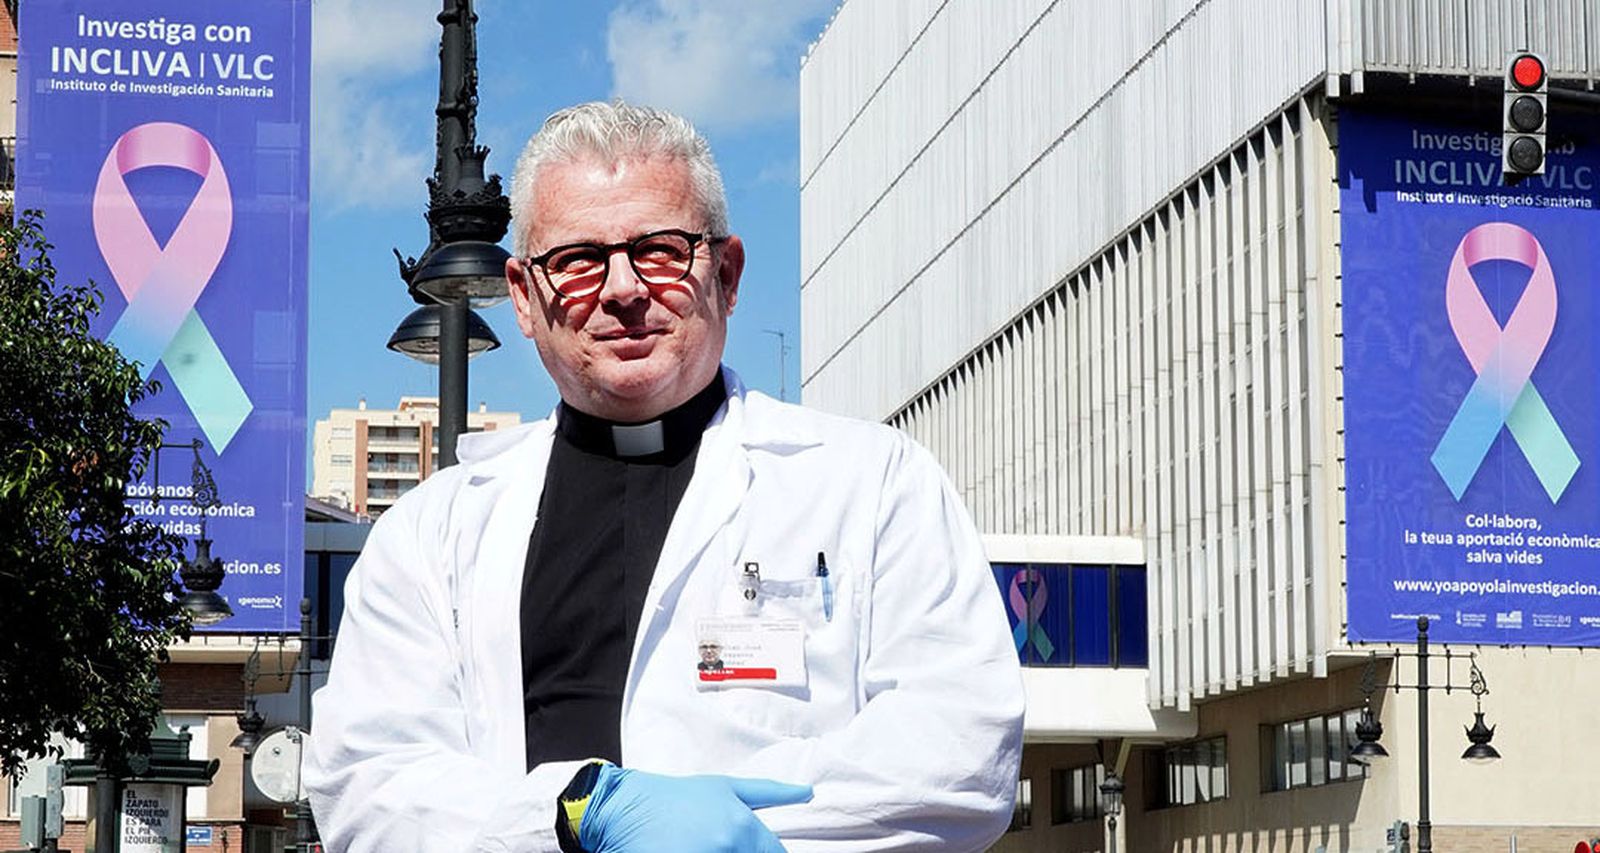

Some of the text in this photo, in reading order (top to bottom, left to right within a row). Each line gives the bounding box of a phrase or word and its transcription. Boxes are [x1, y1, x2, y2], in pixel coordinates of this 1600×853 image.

[78, 14, 251, 45] Investiga con
[51, 46, 274, 80] INCLIVA VLC
[51, 79, 273, 98] Instituto de Investigación Sanitaria
[1412, 129, 1503, 157] Investig
[1541, 165, 1592, 190] VLC
[1396, 190, 1444, 204] Institut
[1535, 194, 1592, 208] Sanitària
[160, 520, 201, 535] vidas
[1405, 530, 1420, 544] la
[1421, 533, 1453, 544] teua
[1457, 532, 1524, 547] aportació
[1466, 549, 1543, 564] salva vides
[127, 790, 137, 798] EL
[126, 799, 159, 808] ZAPATO
[125, 808, 169, 818] IZQUIERDO
[126, 818, 162, 827] ES PARA
[126, 827, 135, 835] EL
[124, 836, 169, 845] IZQUIERDO
